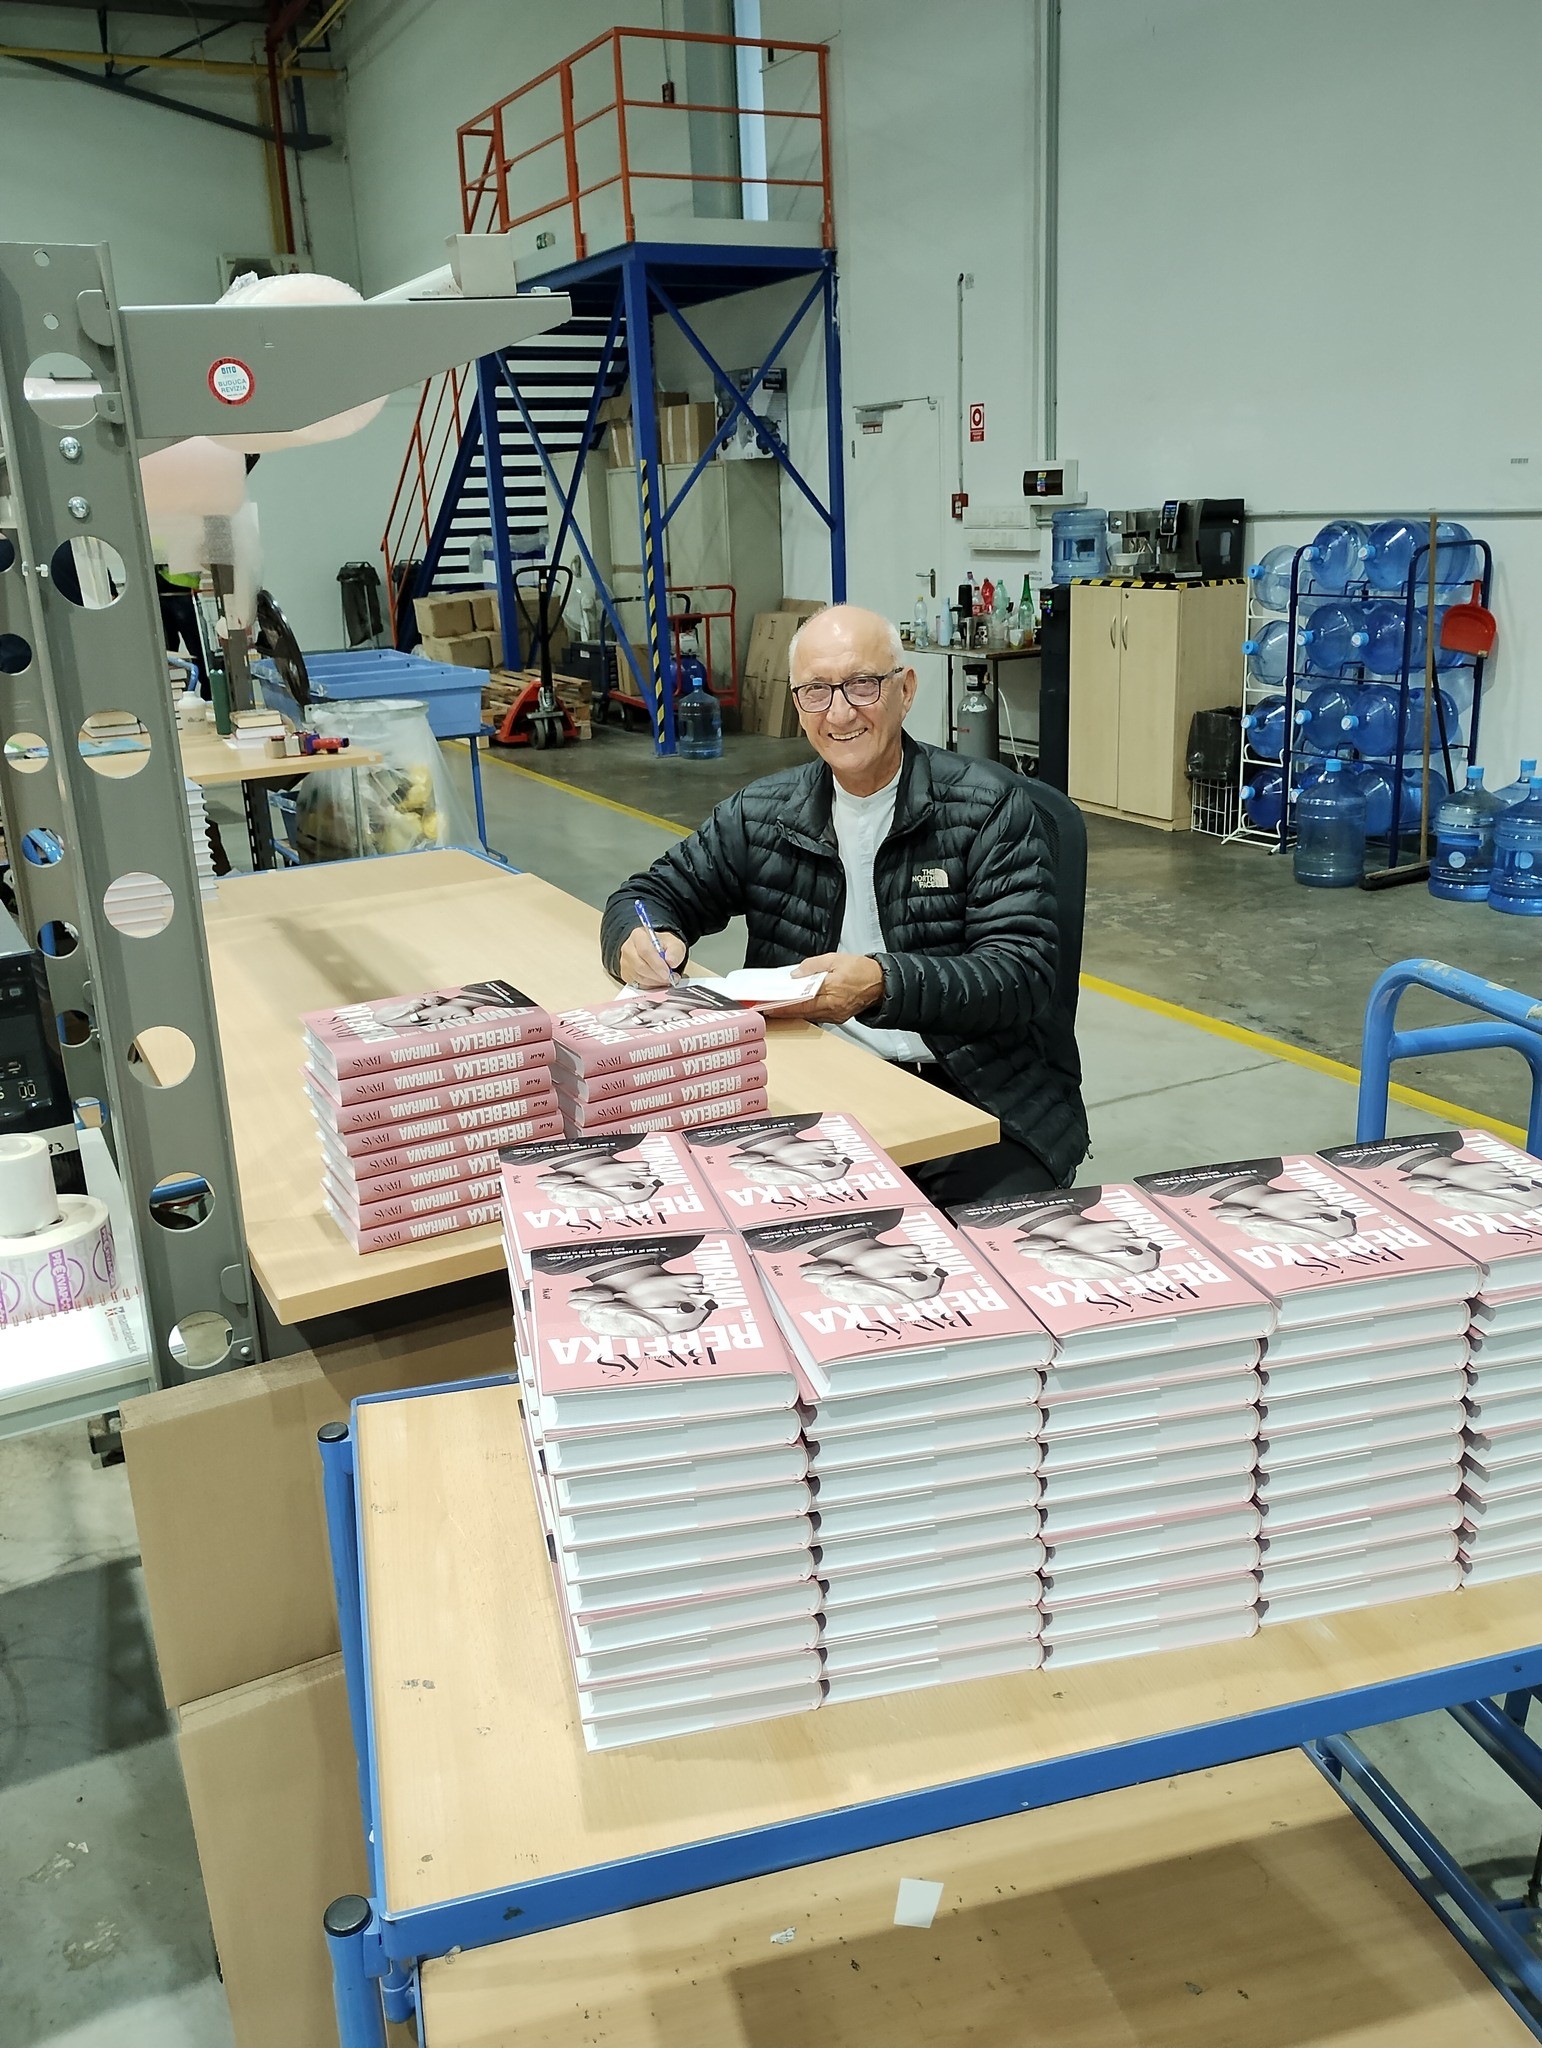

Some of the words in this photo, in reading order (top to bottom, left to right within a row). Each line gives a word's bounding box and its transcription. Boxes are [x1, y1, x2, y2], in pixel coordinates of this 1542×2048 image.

[450, 1027, 514, 1055] REBELKA
[679, 1027, 733, 1053] REBELKA
[391, 1042, 442, 1063] TIMRAVA
[629, 1043, 672, 1063] TIMRAVA
[682, 1050, 735, 1075] REBELKA
[453, 1053, 516, 1081] REBELKA
[633, 1066, 675, 1086] TIMRAVA
[393, 1068, 445, 1090] TIMRAVA
[681, 1076, 735, 1101] REBELKA
[449, 1079, 512, 1107] REBELKA
[630, 1092, 673, 1112] TIMRAVA
[390, 1096, 441, 1118] TIMRAVA
[457, 1100, 520, 1129] REBELKA
[681, 1099, 735, 1125] REBELKA
[398, 1118, 449, 1140] TIMRAVA
[630, 1115, 673, 1133] TIMRAVA
[464, 1123, 526, 1151] REBELKA
[406, 1141, 456, 1163] TIMRAVA
[468, 1152, 499, 1173] ELKA
[410, 1165, 460, 1187] TIMRAVA
[411, 1190, 460, 1212] TIMRAVA
[467, 1204, 501, 1224] ELKA
[1433, 1209, 1542, 1237] ELKA
[409, 1215, 459, 1238] TIMRAVA
